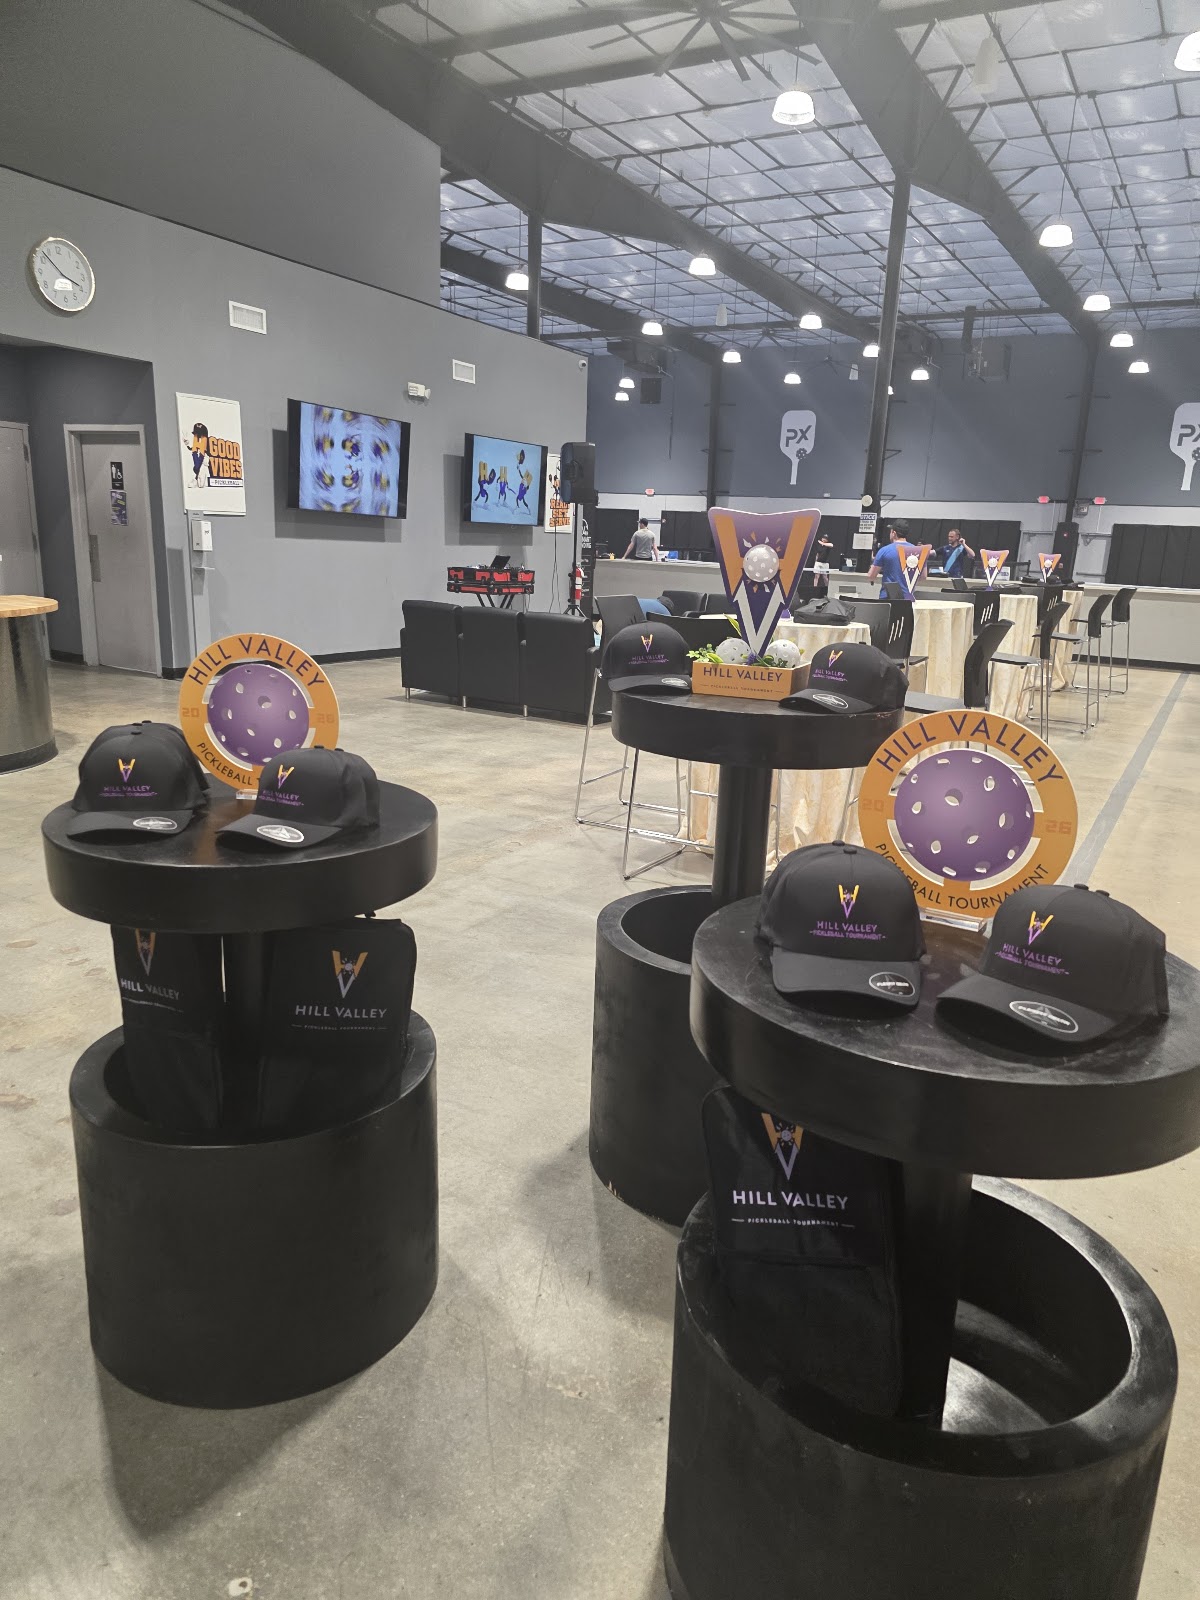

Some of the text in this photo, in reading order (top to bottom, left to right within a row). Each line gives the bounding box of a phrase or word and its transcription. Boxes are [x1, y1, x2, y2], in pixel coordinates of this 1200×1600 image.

[785, 424, 812, 447] PX
[208, 436, 240, 460] GOOD
[209, 457, 242, 479] VIBES
[552, 509, 568, 518] SET
[549, 517, 571, 527] SERVE
[188, 636, 325, 686] HILL VALLEY
[703, 666, 783, 682] HILL VALLEY
[181, 707, 200, 718] 20
[876, 713, 1064, 783] HILL VALLEY
[197, 742, 253, 786] PICKLEBALL
[275, 791, 300, 800] VALLEY
[861, 799, 884, 813] 20
[1045, 819, 1072, 835] 26
[817, 920, 878, 933] HILL VALLEY
[1002, 943, 1020, 956] HILL
[1022, 948, 1062, 966] VALLEY
[120, 977, 180, 1000] HILL VALLEY
[295, 1004, 387, 1019] HILL VALLEY
[732, 1190, 849, 1210] HILL VALLEY
[793, 1219, 839, 1227] TOURNAMENT
